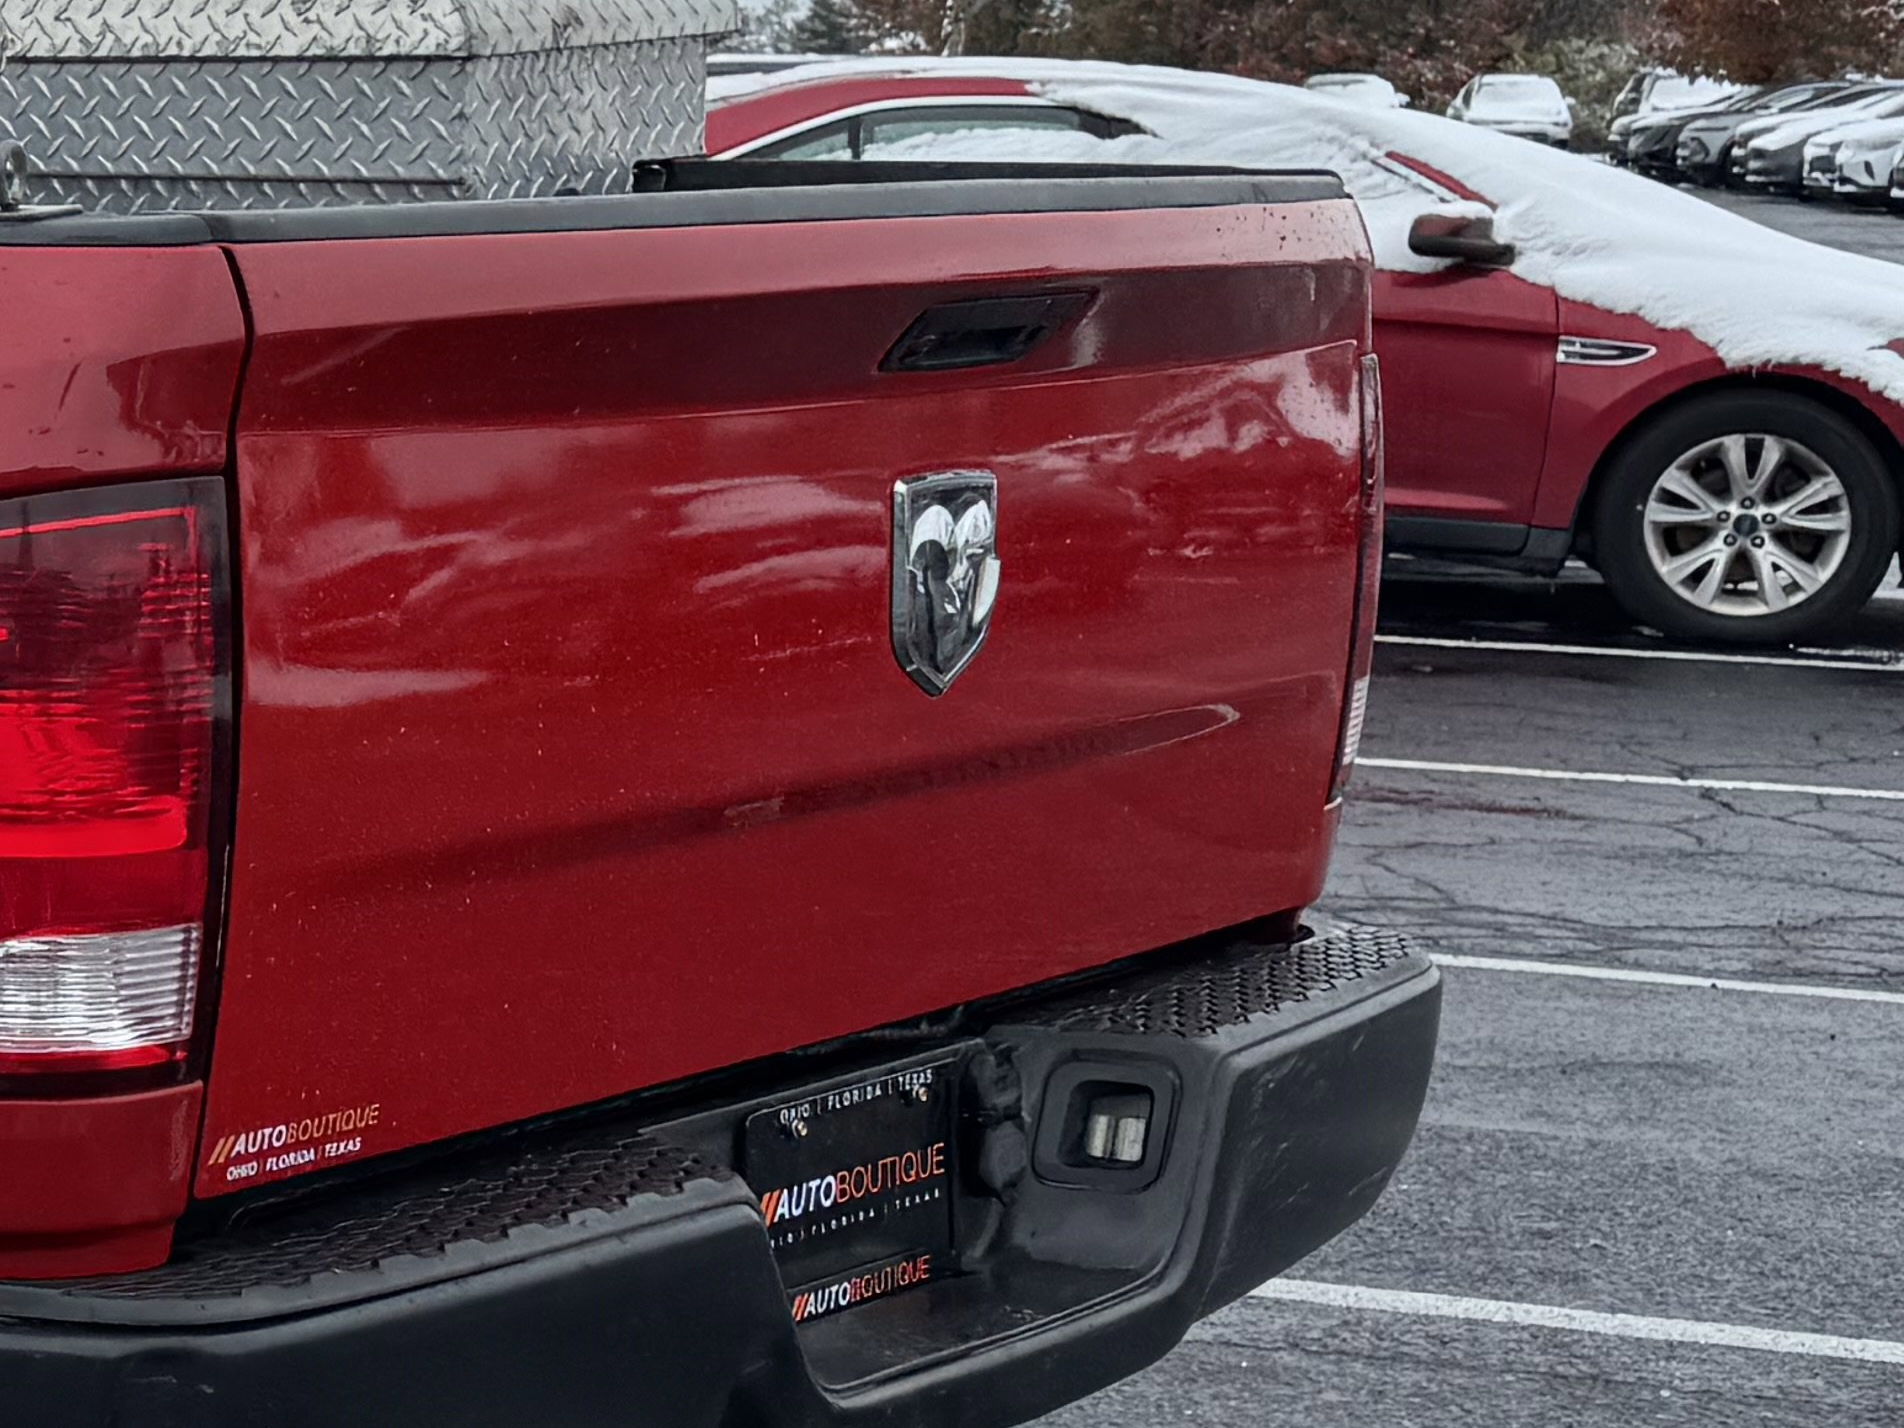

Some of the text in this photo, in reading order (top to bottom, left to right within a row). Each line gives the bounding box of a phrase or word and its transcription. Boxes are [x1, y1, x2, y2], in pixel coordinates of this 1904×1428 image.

[827, 1083, 883, 1110] FLORIDA
[898, 1068, 933, 1091] TEXAS
[226, 1136, 362, 1181] OHIO FLORIDA TEXAS
